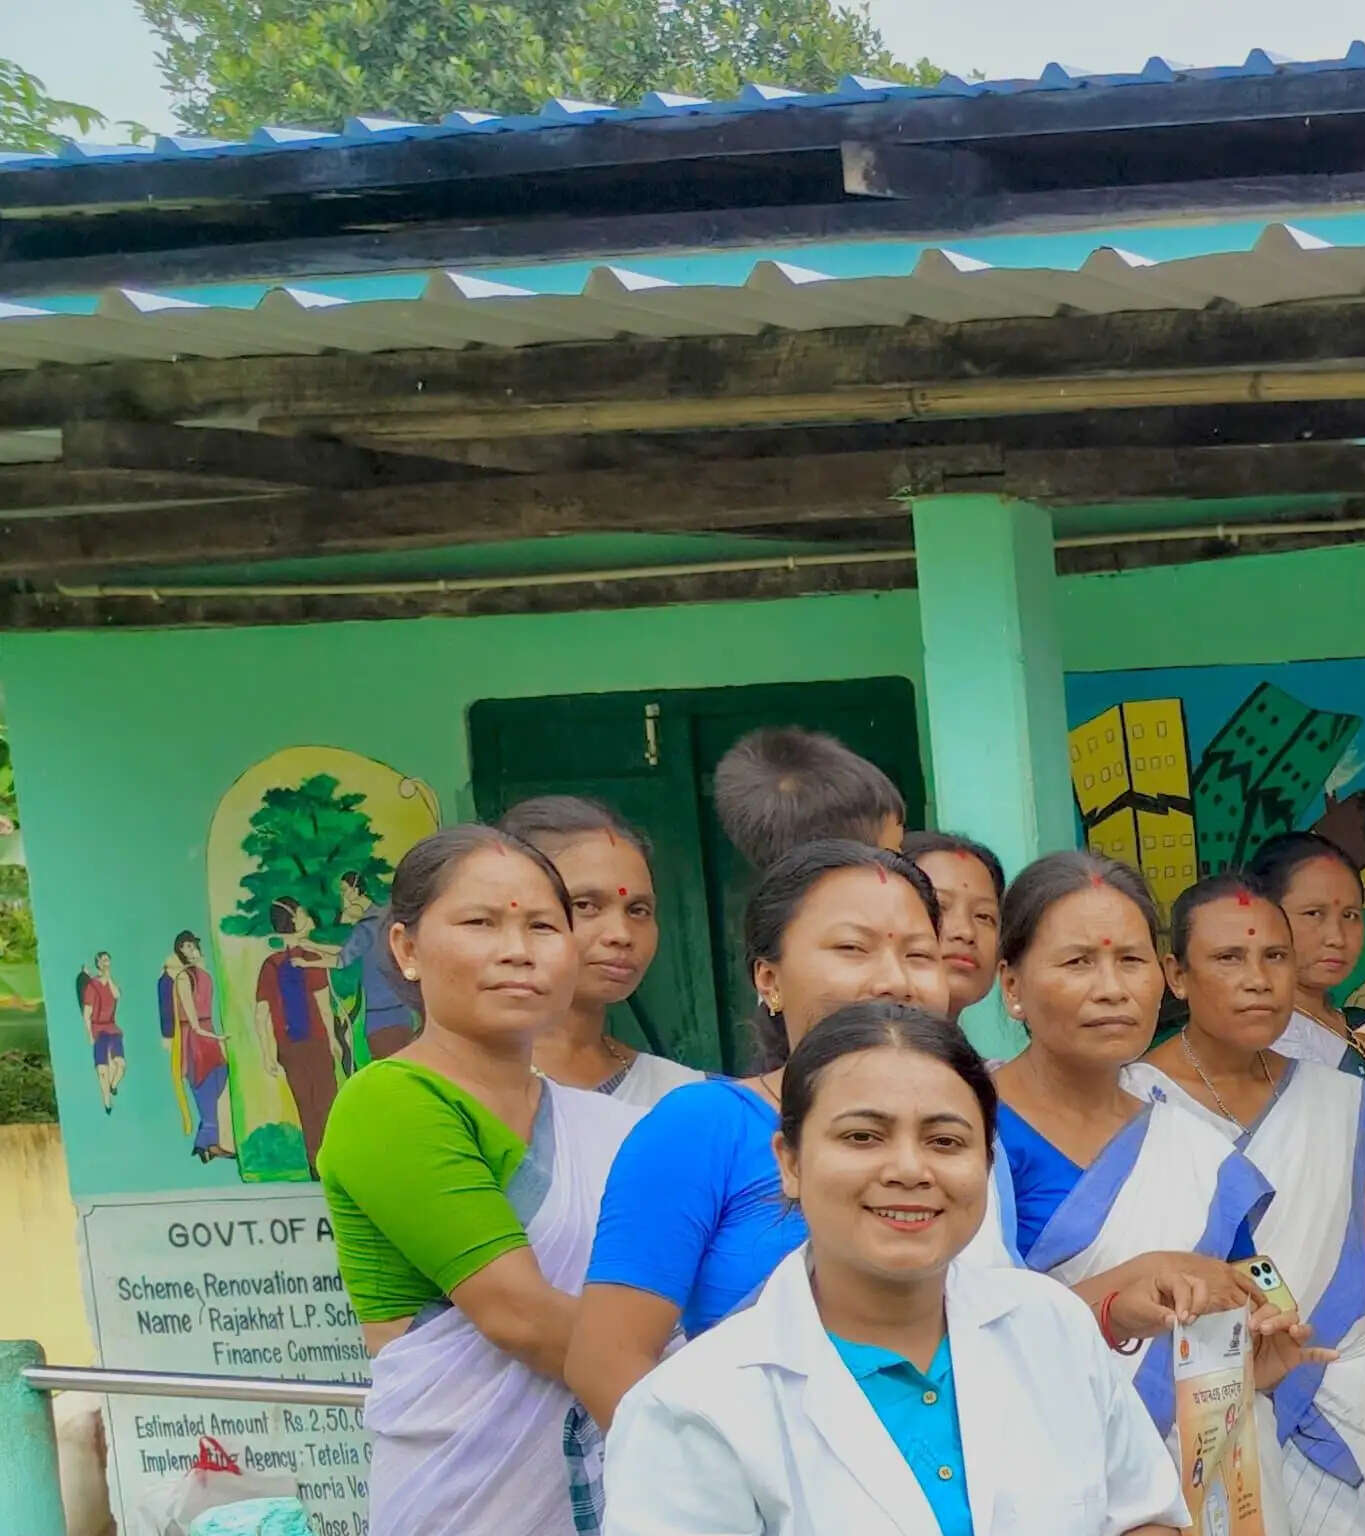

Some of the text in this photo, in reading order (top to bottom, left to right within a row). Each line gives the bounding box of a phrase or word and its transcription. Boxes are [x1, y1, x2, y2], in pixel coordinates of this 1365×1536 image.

[168, 1220, 264, 1248] GOVT.
[270, 1217, 306, 1245] OF
[203, 1269, 344, 1298] Renovation and
[136, 1310, 193, 1335] Name
[208, 1305, 285, 1337] Rajakhat
[325, 1302, 359, 1327] Sch
[213, 1336, 372, 1366] Finance Commissi
[134, 1412, 206, 1439] Estimated
[210, 1409, 269, 1436] Amount
[304, 1442, 360, 1468] Tetelia
